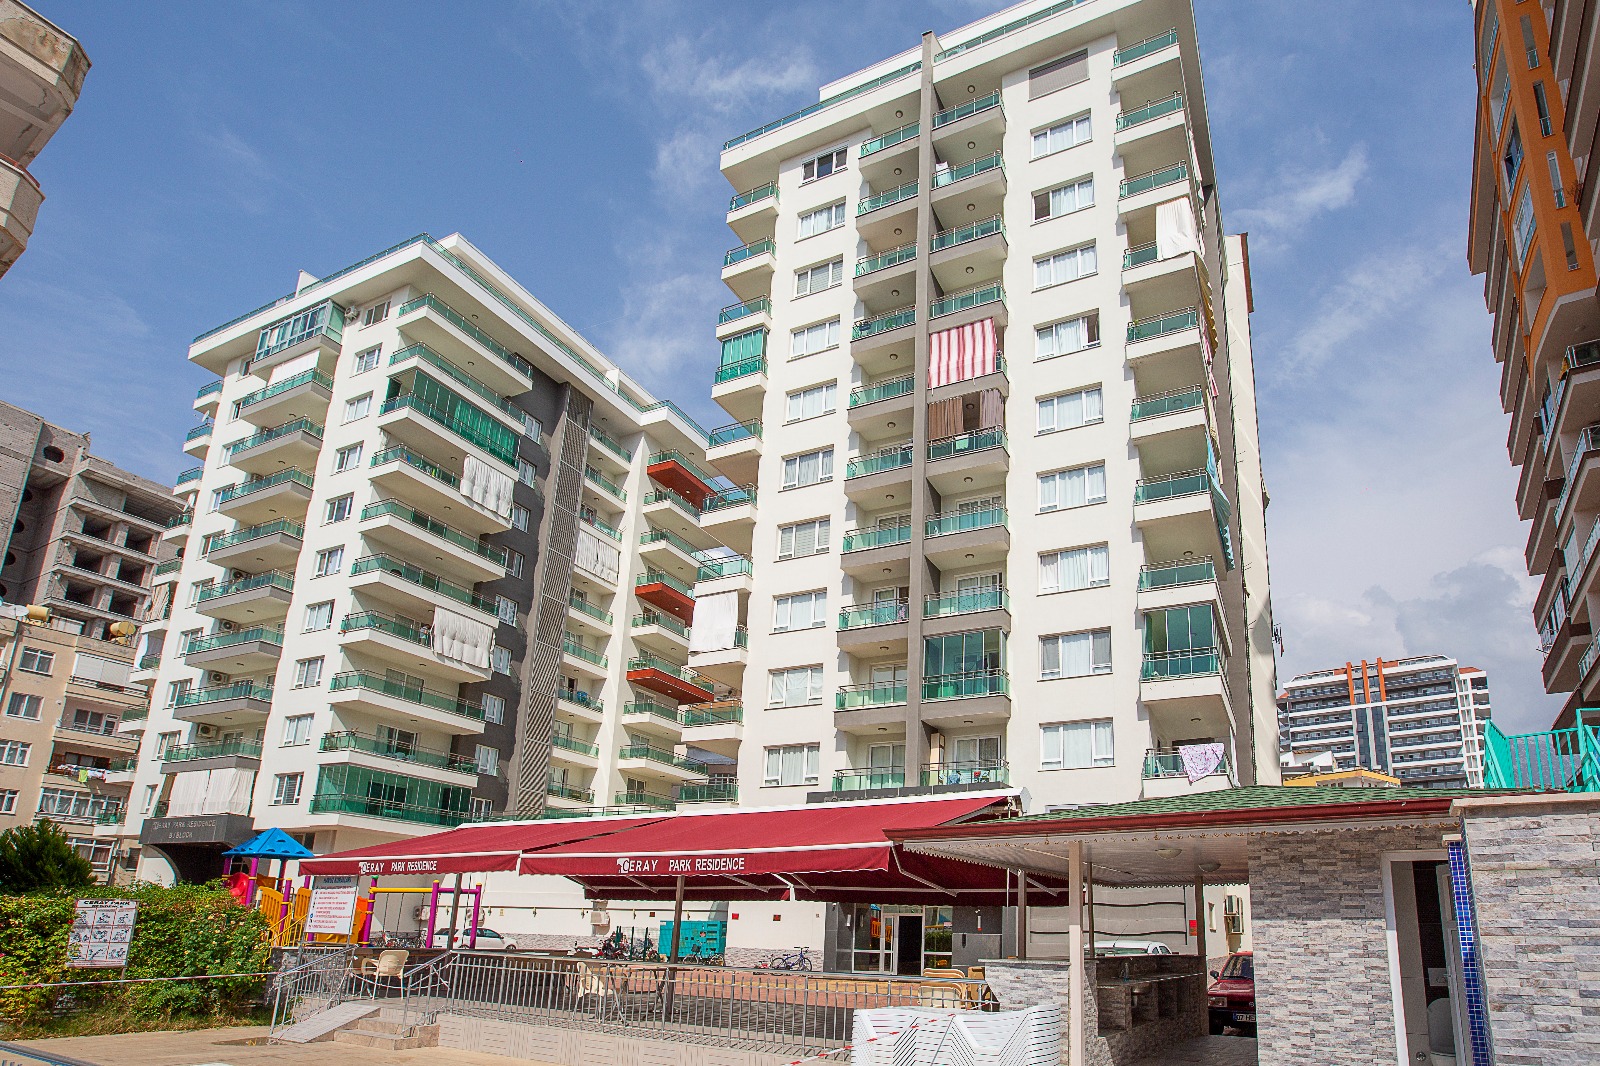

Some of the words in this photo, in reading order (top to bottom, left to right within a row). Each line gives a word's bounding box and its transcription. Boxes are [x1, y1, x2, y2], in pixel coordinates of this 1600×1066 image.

[391, 861, 405, 872] PARK
[407, 860, 438, 871] RESIDENCE
[668, 859, 692, 871] PARK
[695, 857, 745, 871] RESIDENCE
